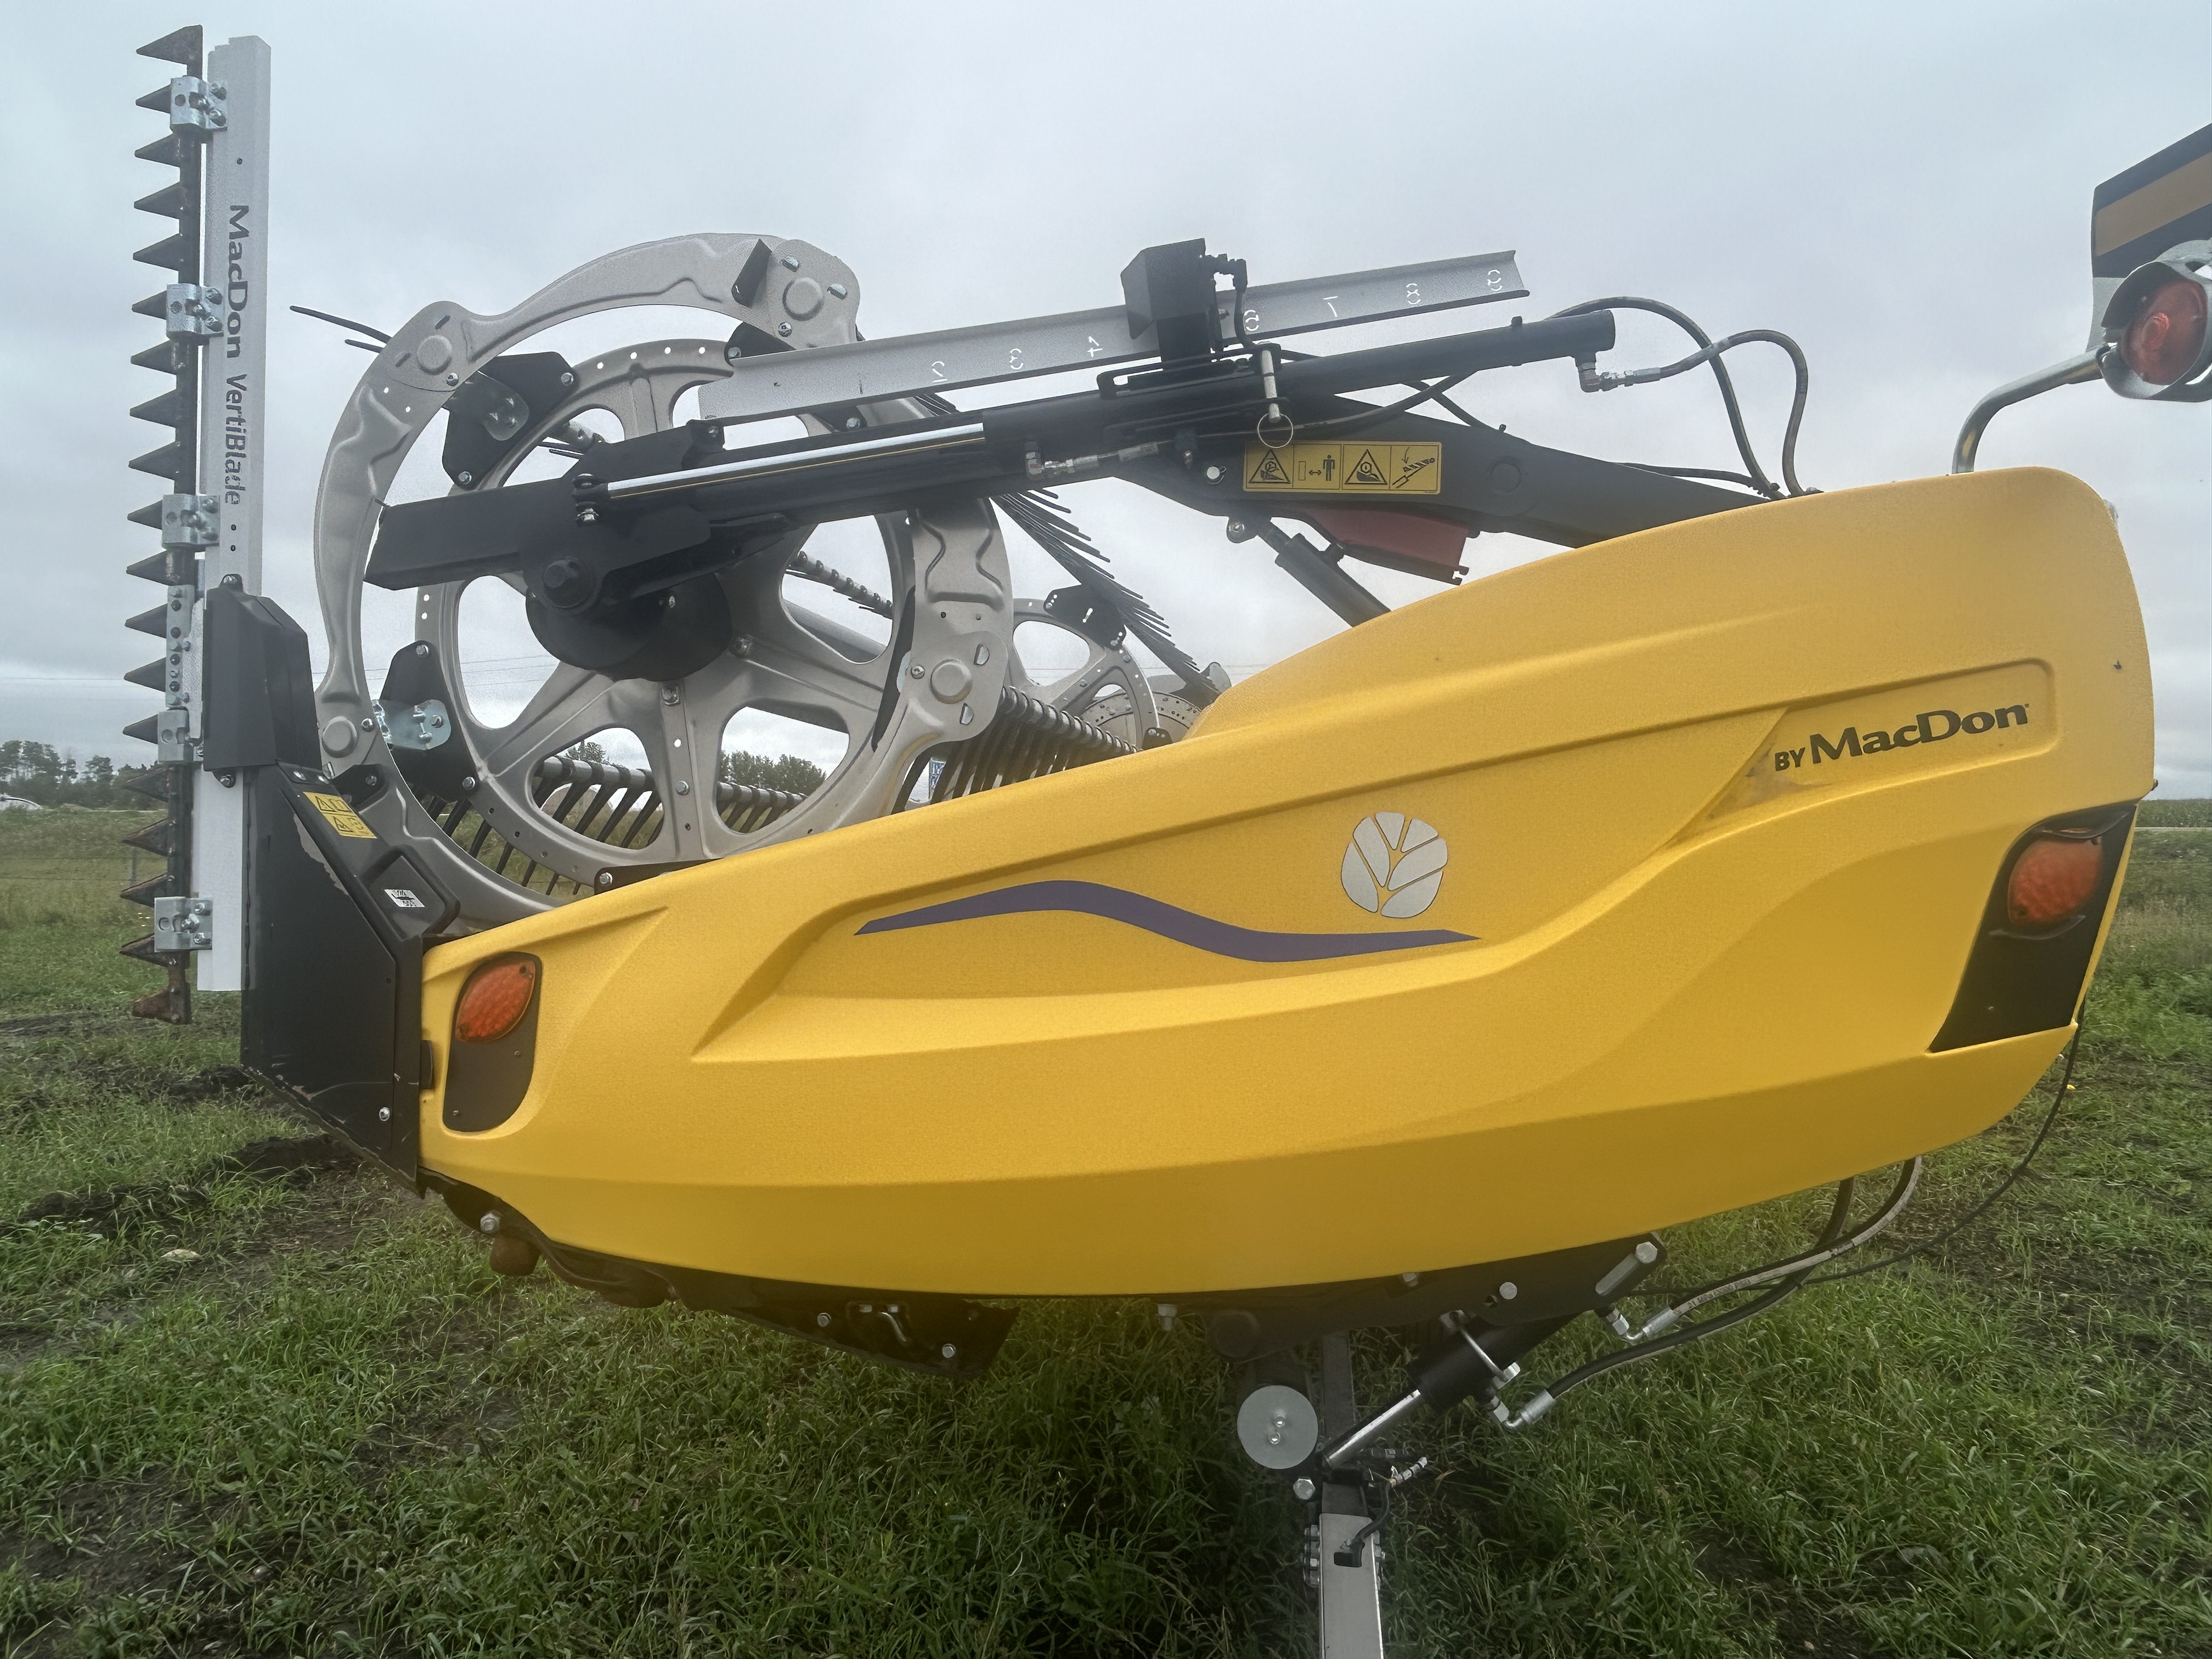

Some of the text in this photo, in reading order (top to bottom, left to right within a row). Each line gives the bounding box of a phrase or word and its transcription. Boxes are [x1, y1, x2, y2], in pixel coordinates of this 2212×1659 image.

[225, 205, 250, 505] MacDon VertiBlade
[1775, 704, 2029, 771] BY MacDon
